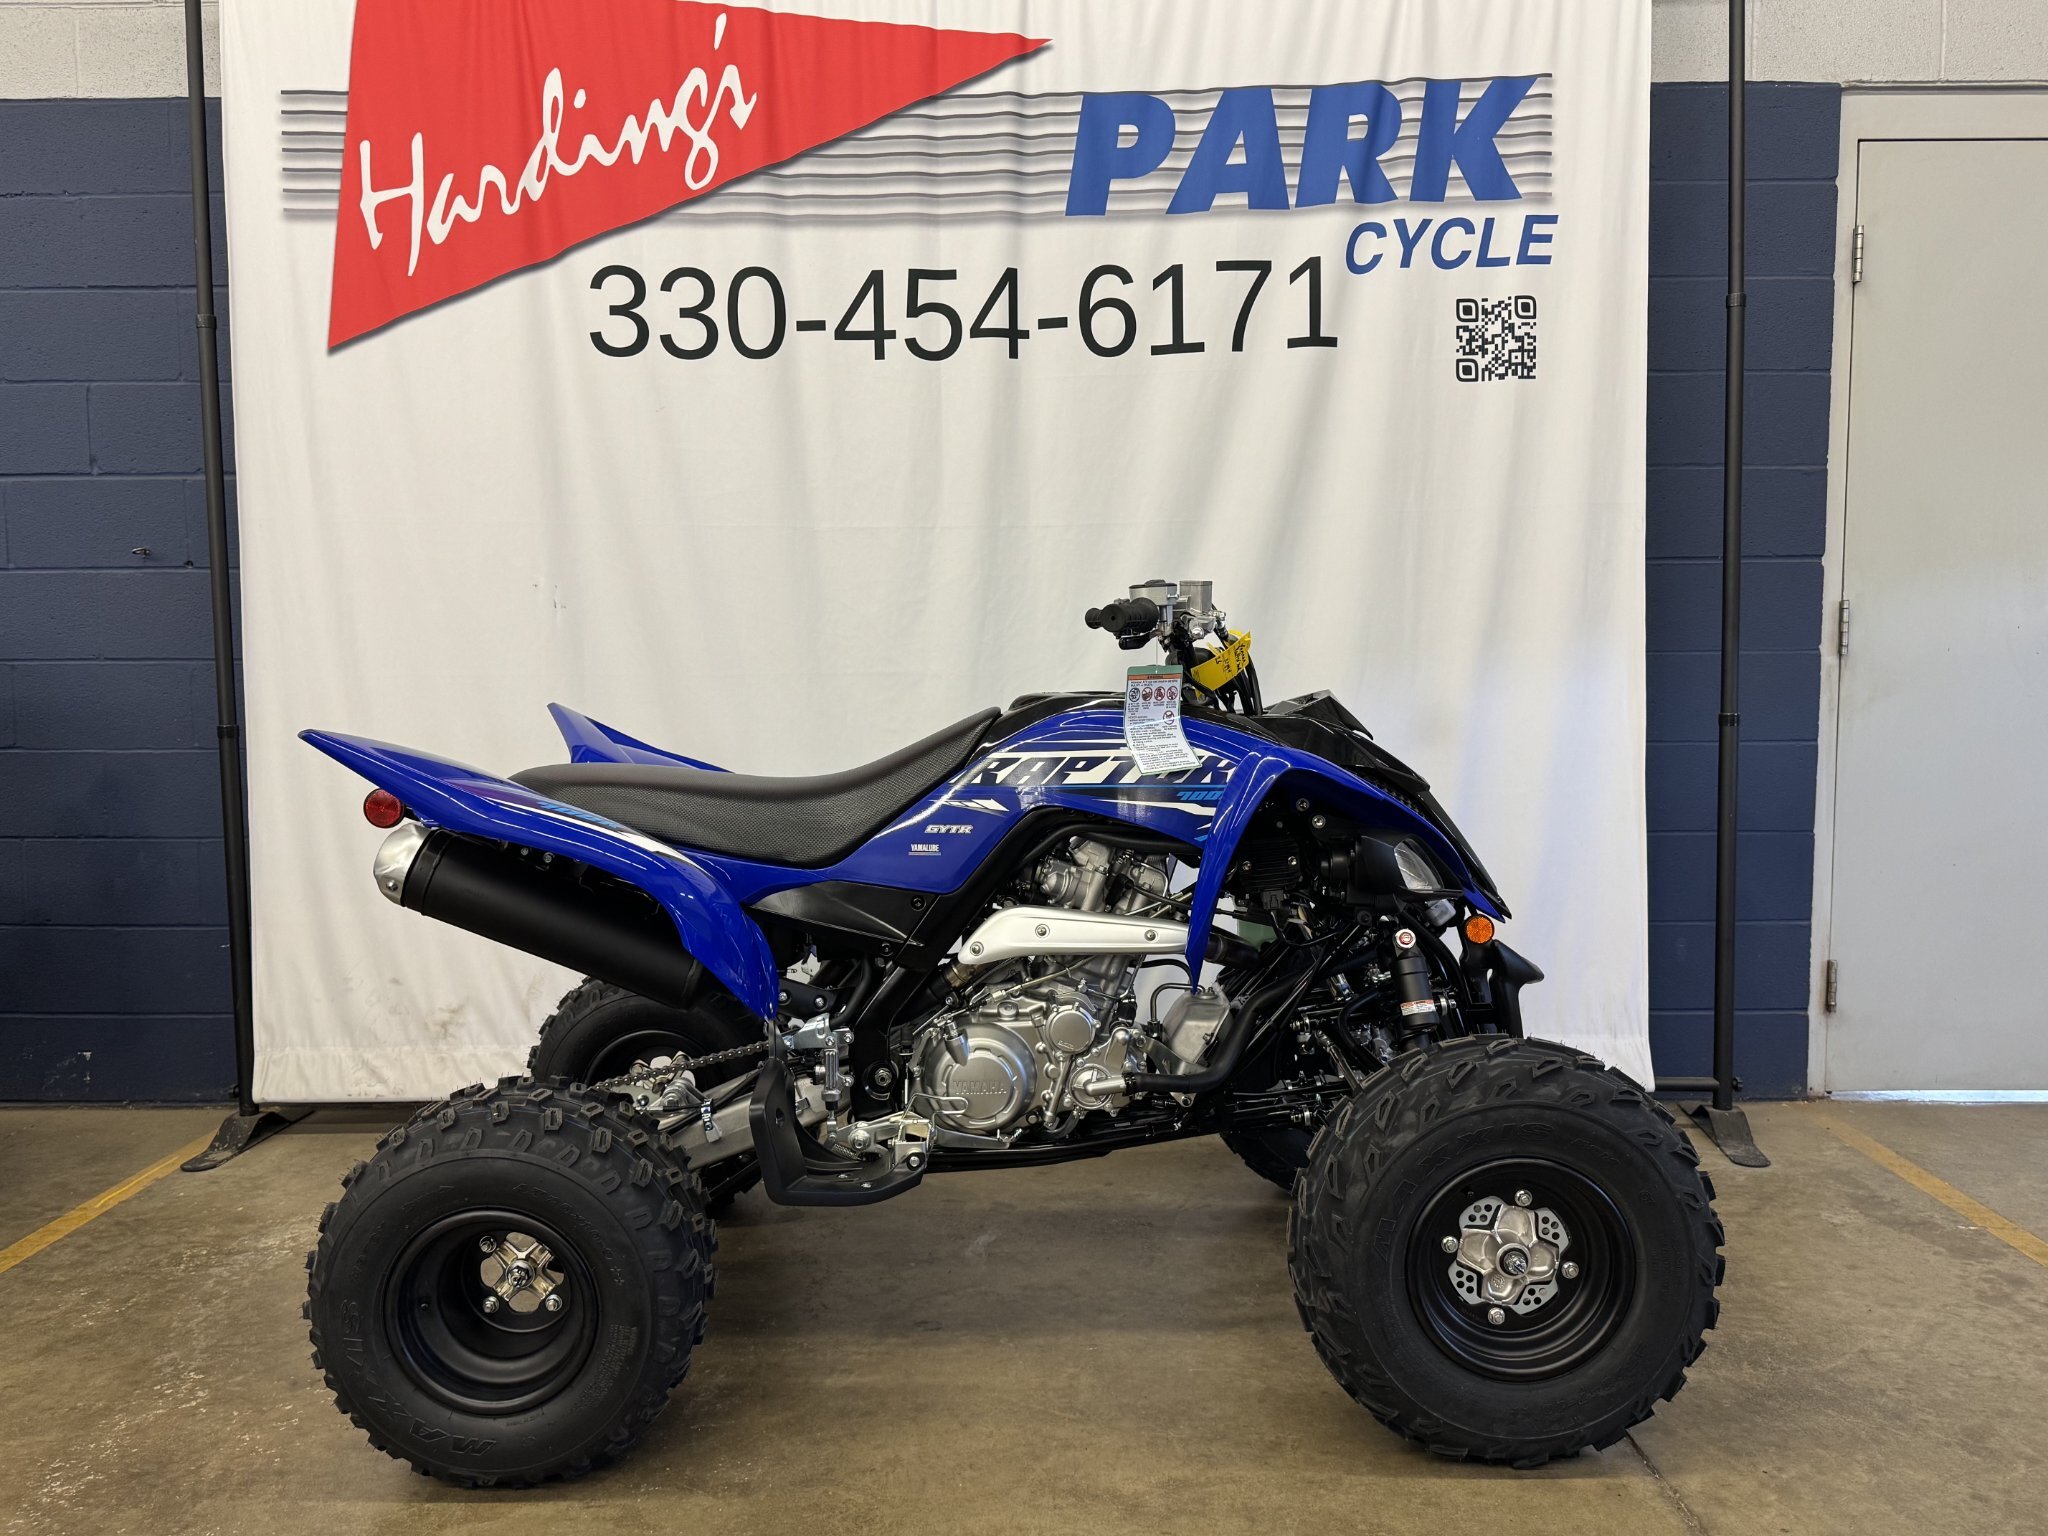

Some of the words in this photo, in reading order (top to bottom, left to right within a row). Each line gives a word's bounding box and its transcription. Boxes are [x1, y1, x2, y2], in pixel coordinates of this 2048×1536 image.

[359, 14, 757, 276] Harding's
[1065, 75, 1540, 216] PARK
[1345, 214, 1558, 275] CYCLE
[589, 255, 1339, 362] 330-454-6171
[910, 843, 940, 852] YAMALUBE
[924, 824, 974, 834] GYTR
